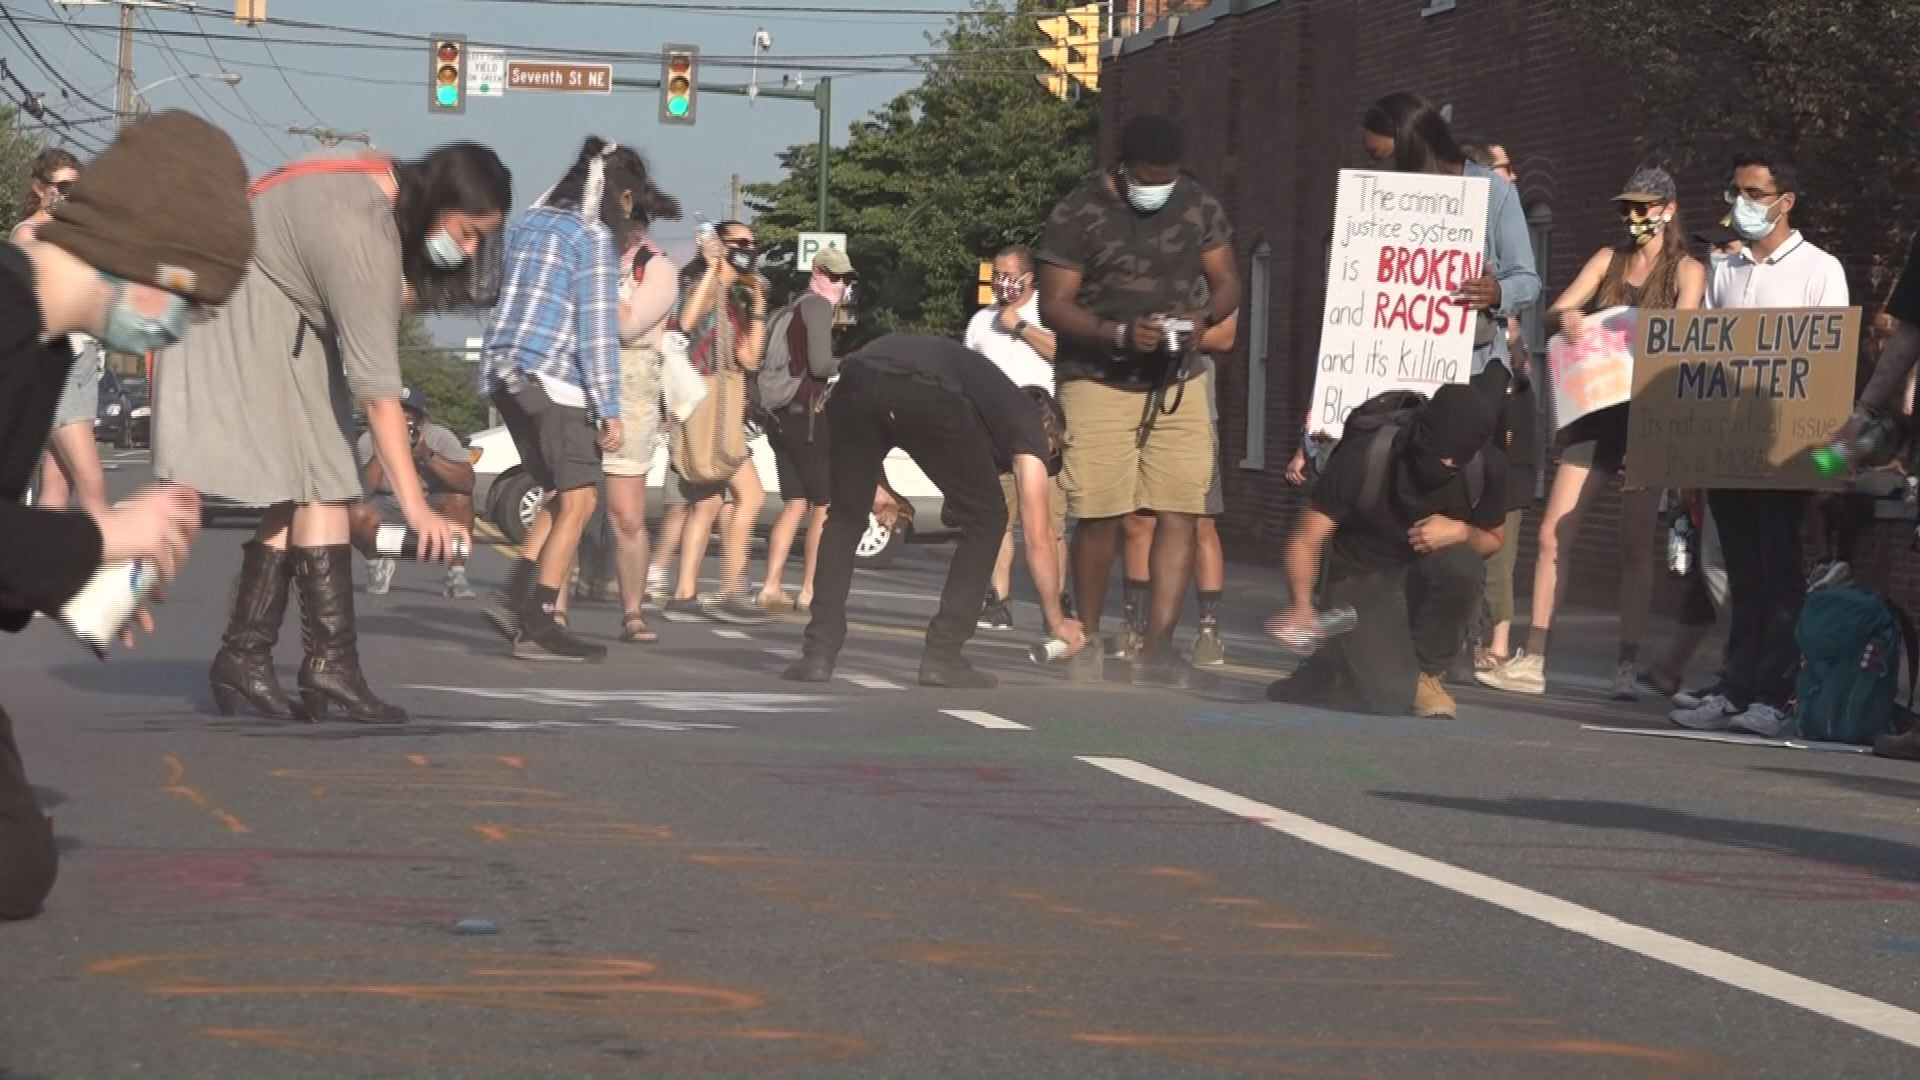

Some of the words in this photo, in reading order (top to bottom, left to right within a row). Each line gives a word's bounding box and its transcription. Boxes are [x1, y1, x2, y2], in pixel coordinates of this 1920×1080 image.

[512, 67, 563, 85] Seventh
[569, 70, 582, 86] St
[588, 72, 605, 87] NE
[1352, 174, 1395, 212] The
[1400, 179, 1466, 216] criminal
[1340, 213, 1402, 247] justice
[1409, 217, 1473, 246] system
[803, 239, 820, 263] P
[1342, 255, 1360, 281] is
[1376, 245, 1482, 291] BROKEN
[1329, 290, 1365, 326] and
[1373, 291, 1471, 335] RACIST
[1646, 314, 1739, 355] BLACK
[1756, 313, 1845, 352] LIVES
[1321, 338, 1356, 374] and
[1676, 356, 1811, 400] MATTER
[1791, 416, 1838, 438] issue
